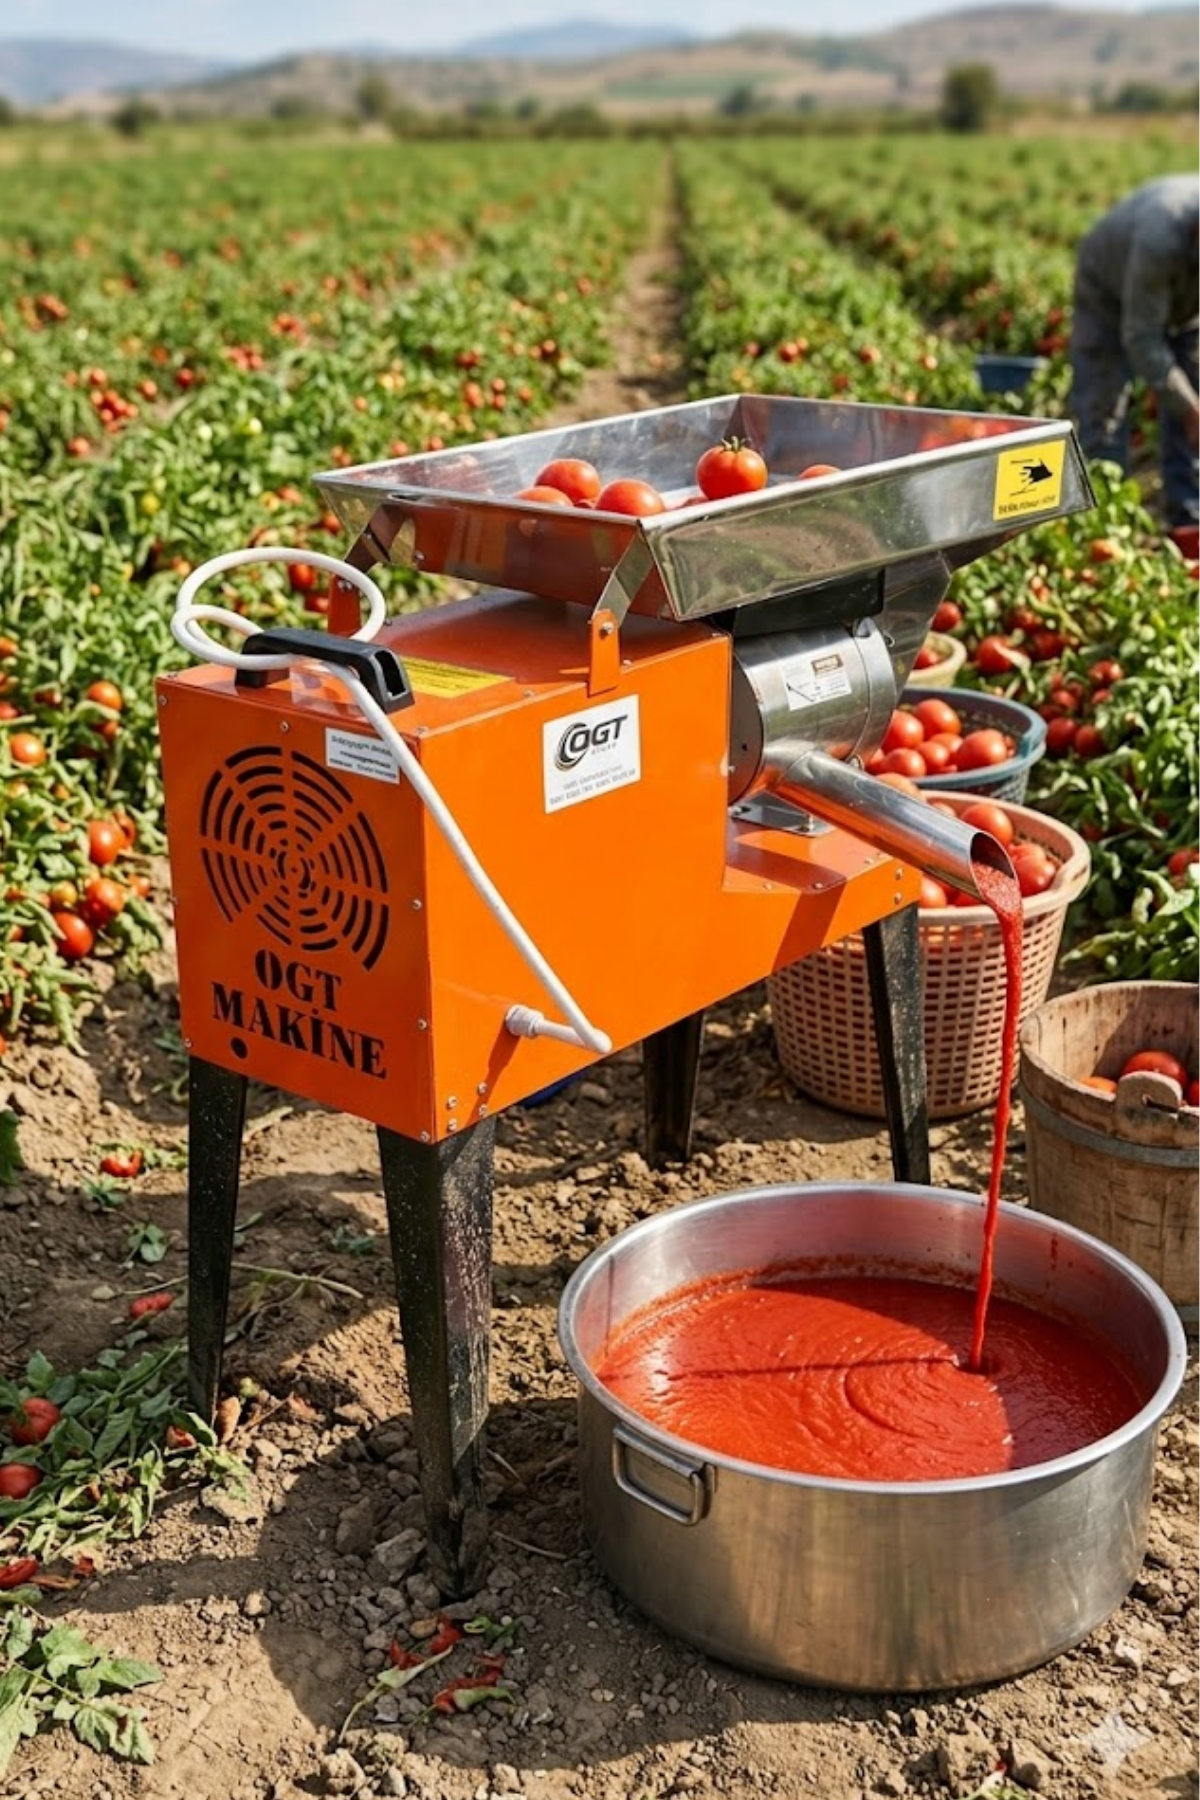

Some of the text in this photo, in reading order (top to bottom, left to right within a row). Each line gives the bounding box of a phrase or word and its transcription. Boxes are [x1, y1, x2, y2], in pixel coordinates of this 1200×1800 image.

[569, 714, 628, 753] OGT
[255, 949, 341, 1011] OGT
[211, 982, 387, 1079] MAKİNE
